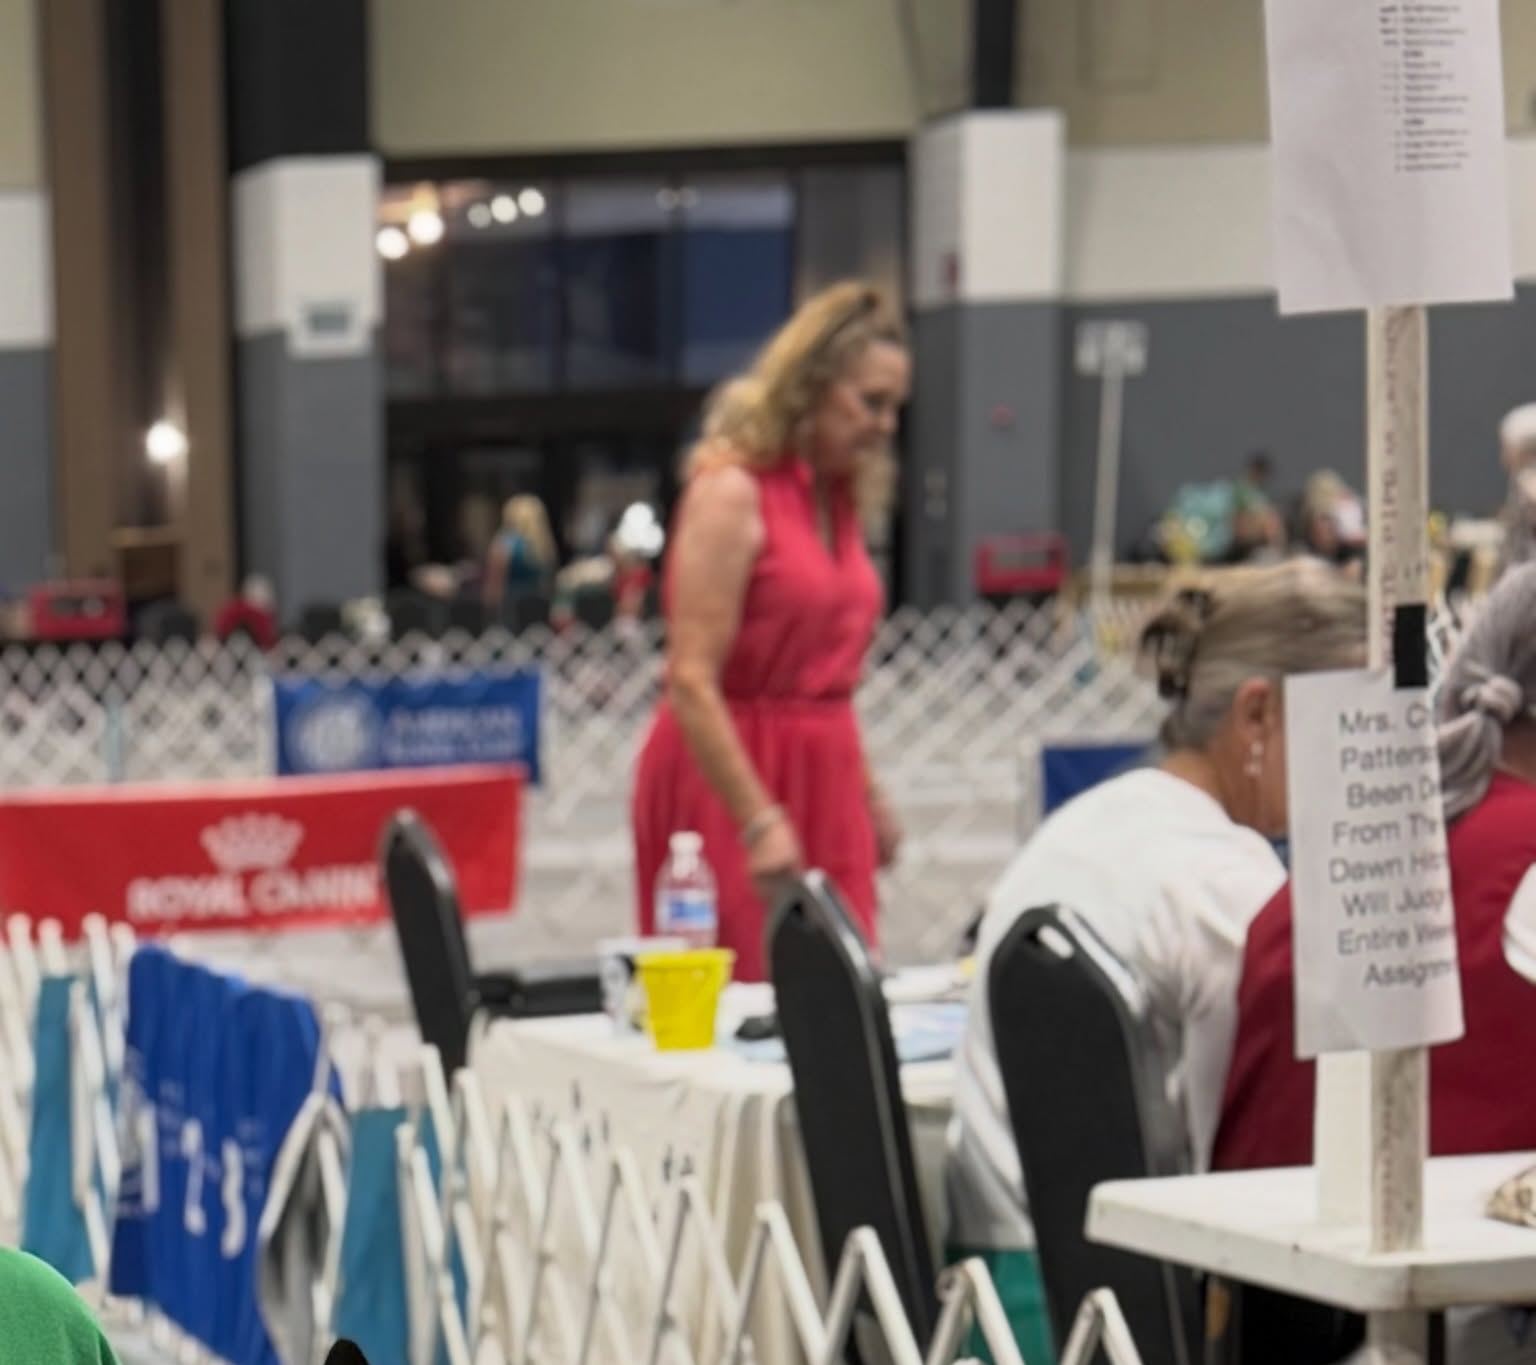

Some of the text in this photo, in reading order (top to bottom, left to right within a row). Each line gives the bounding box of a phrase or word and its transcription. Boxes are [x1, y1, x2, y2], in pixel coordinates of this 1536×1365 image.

[1338, 709, 1397, 736] Mrs.
[1346, 783, 1414, 810] Been
[1332, 820, 1401, 846] From
[1329, 856, 1404, 884] Dawn
[125, 862, 380, 926] ROYAL CANIN
[1341, 890, 1390, 917] Will
[1337, 926, 1409, 956] Entire
